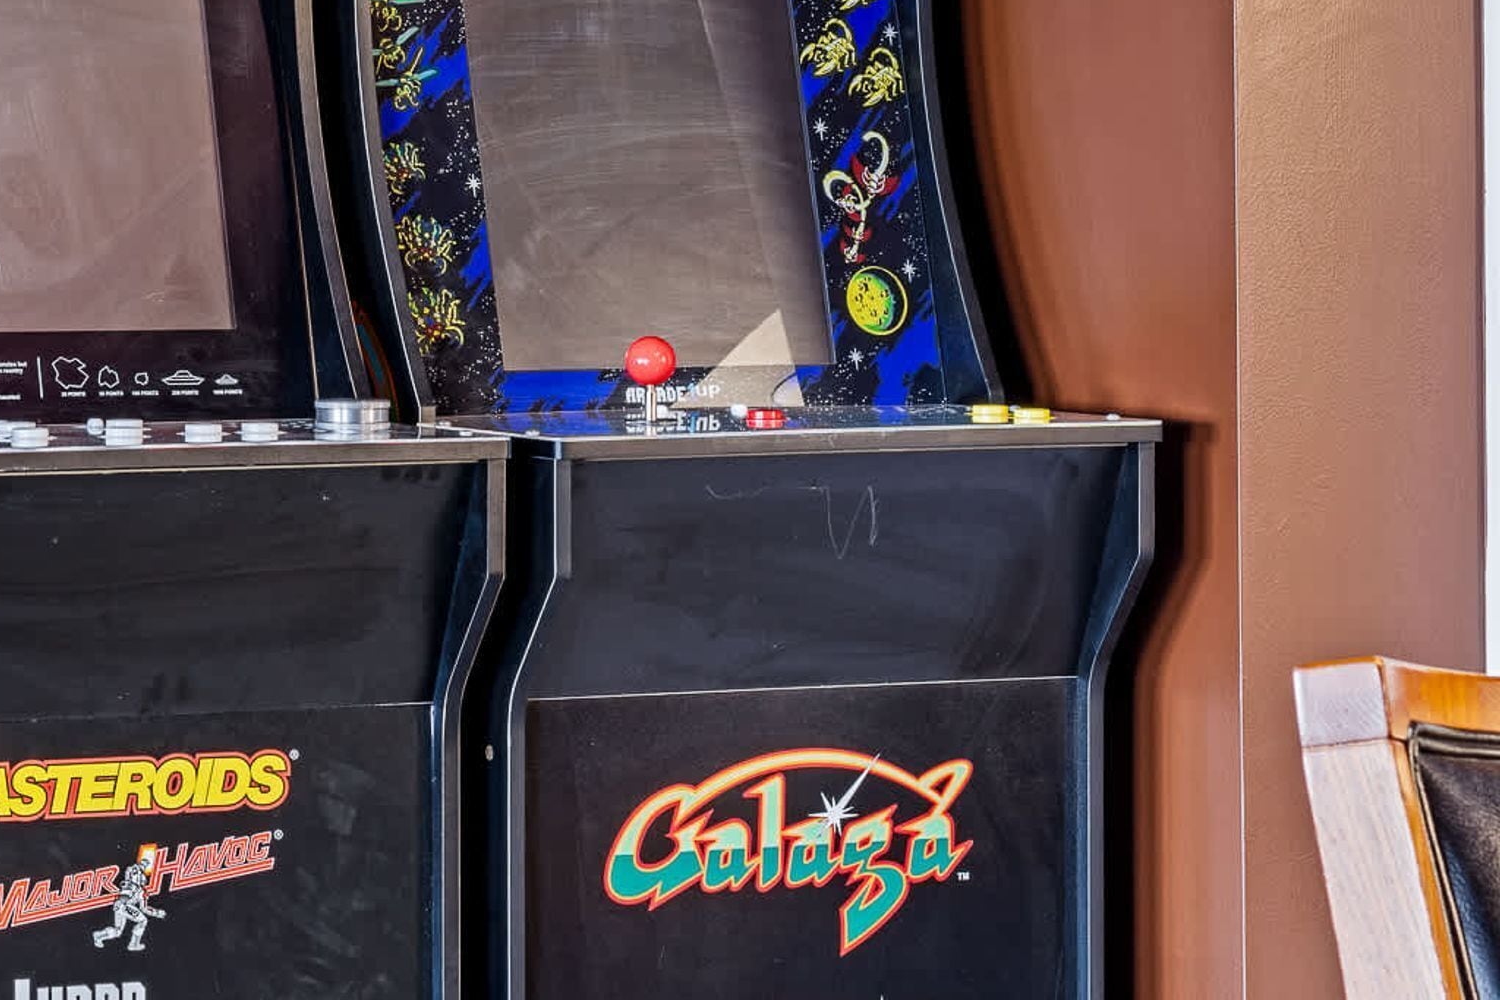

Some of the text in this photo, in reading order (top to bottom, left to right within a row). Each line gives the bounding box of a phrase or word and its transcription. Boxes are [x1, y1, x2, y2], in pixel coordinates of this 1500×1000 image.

[625, 383, 721, 404] ARADE1UP
[146, 831, 275, 896] HAVOC
[603, 748, 974, 956] Galaga
